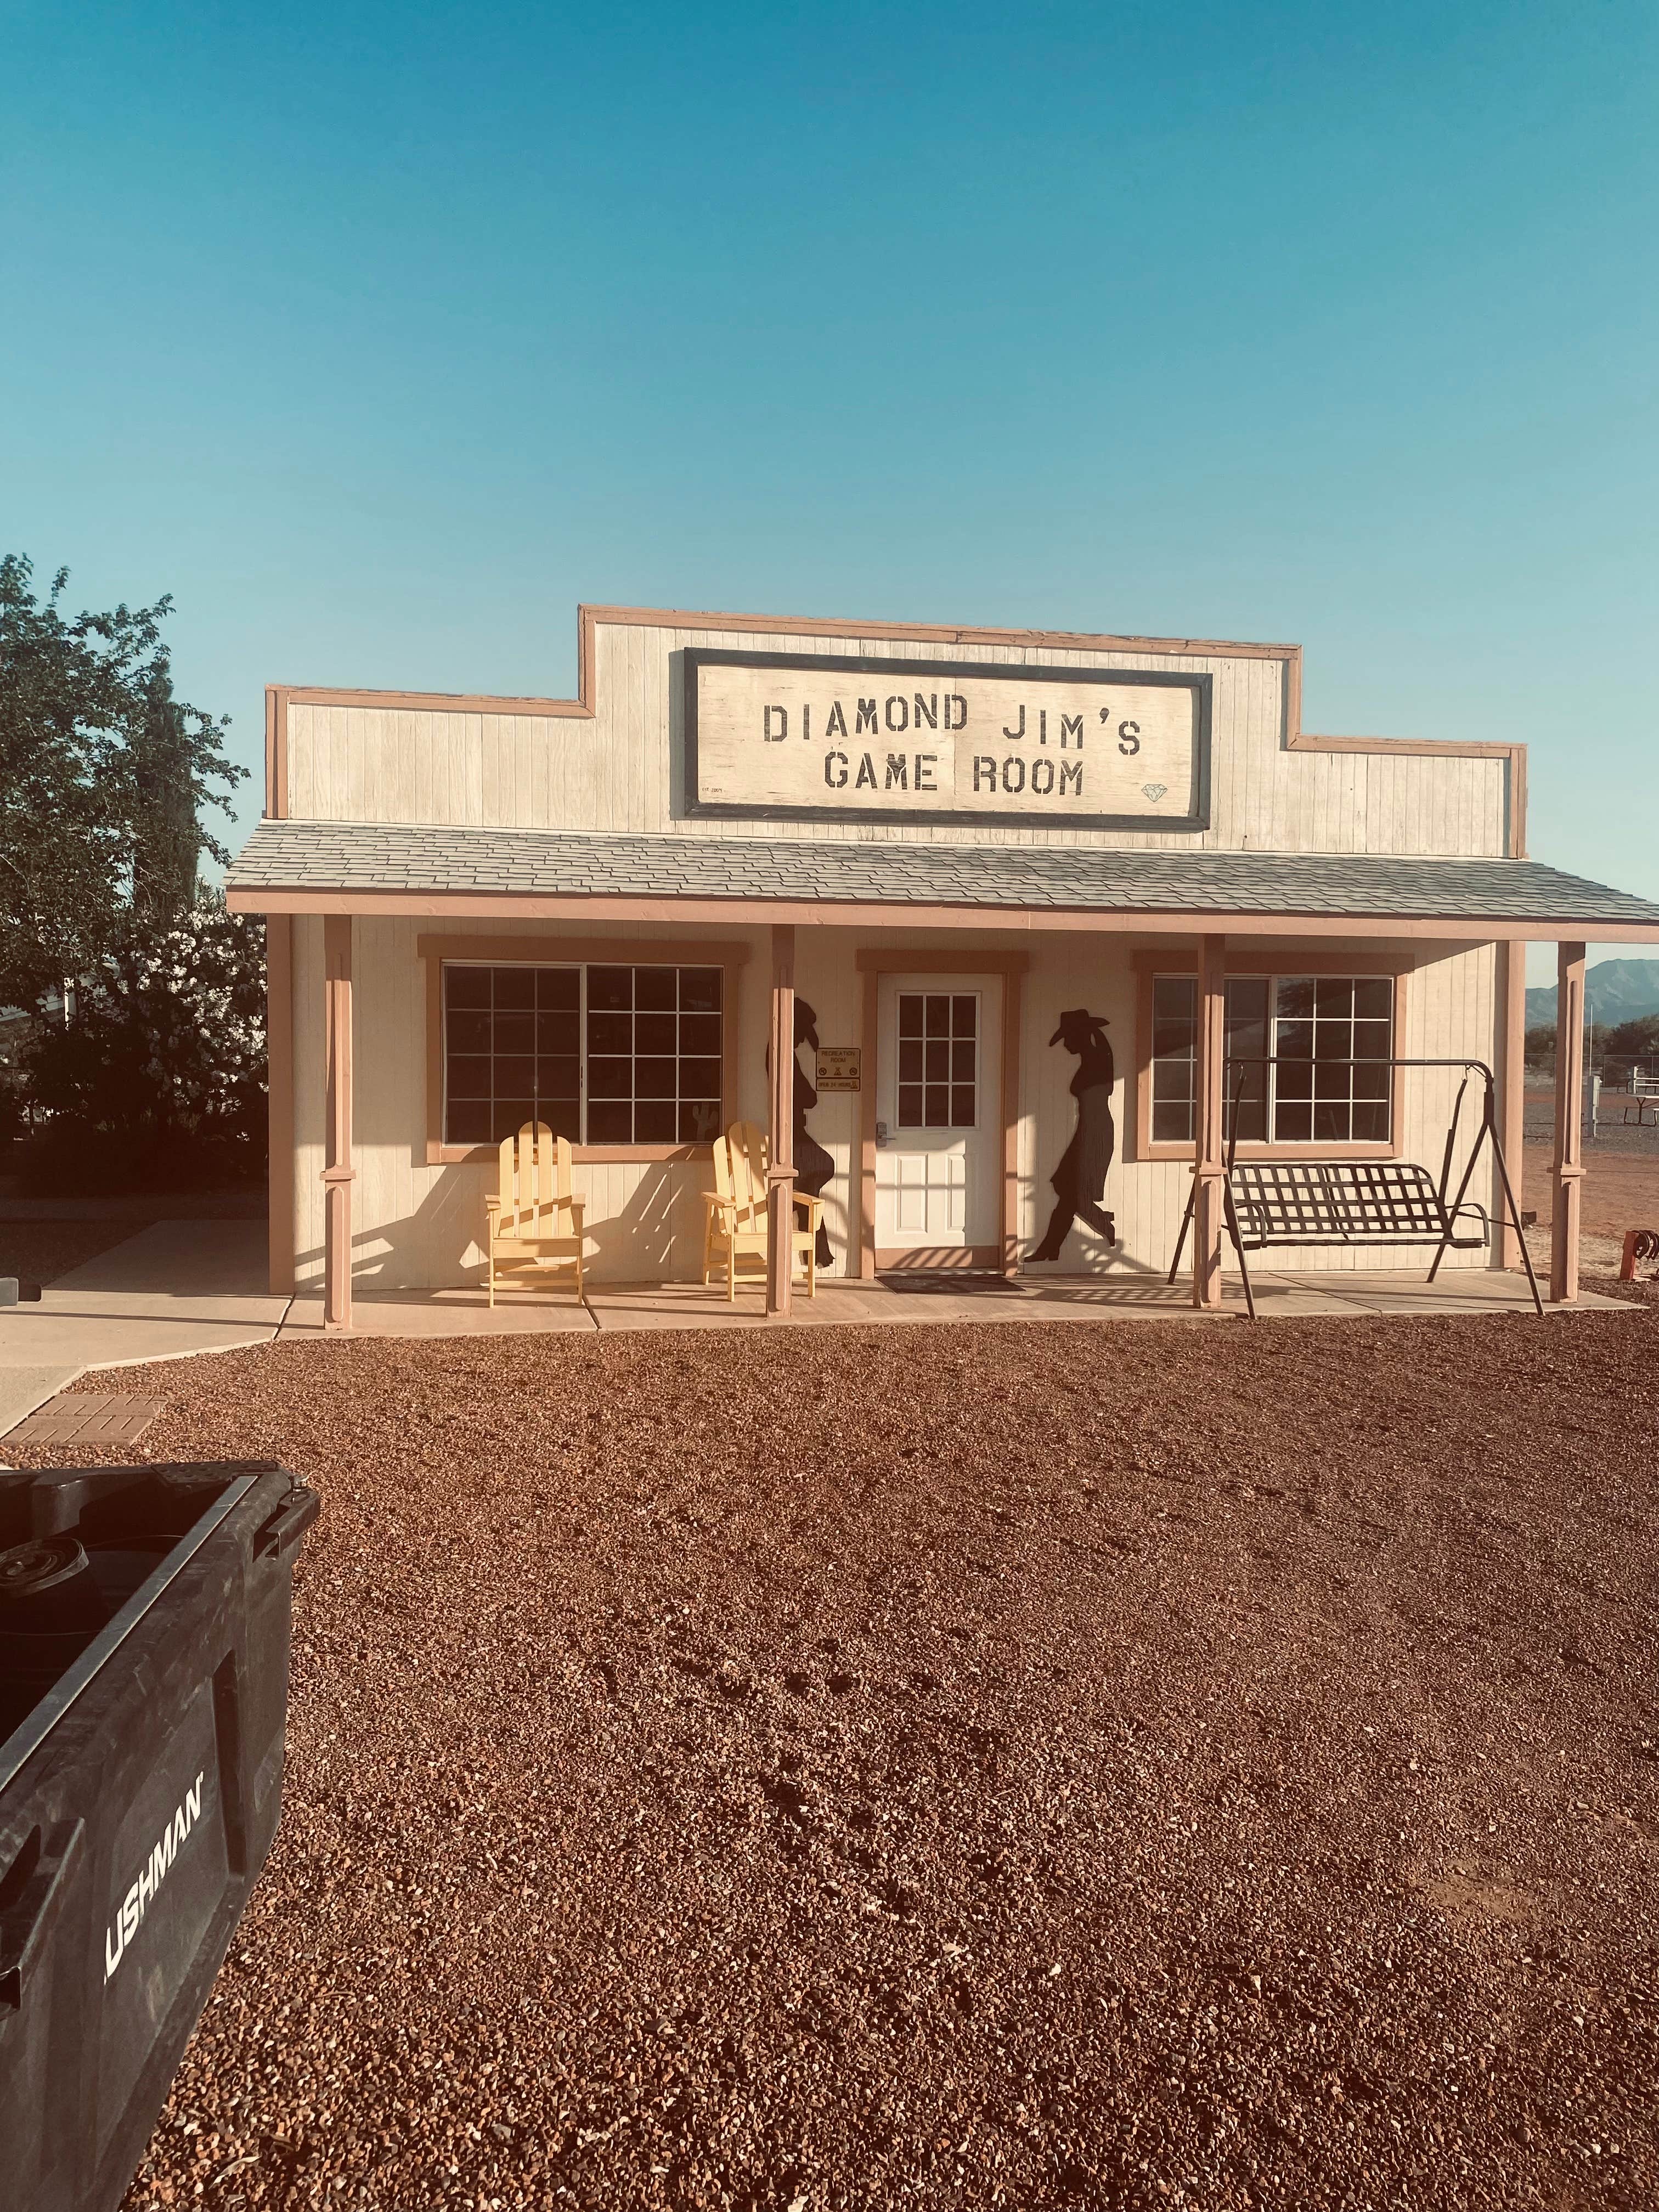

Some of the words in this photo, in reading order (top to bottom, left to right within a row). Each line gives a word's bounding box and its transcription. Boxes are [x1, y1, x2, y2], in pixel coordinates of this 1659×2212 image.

[764, 693, 967, 742] DIAMOND
[1003, 704, 1140, 755] JIM'S
[825, 752, 938, 791] GAME
[974, 756, 1083, 795] ROOM
[103, 1772, 204, 1985] USHMAN
